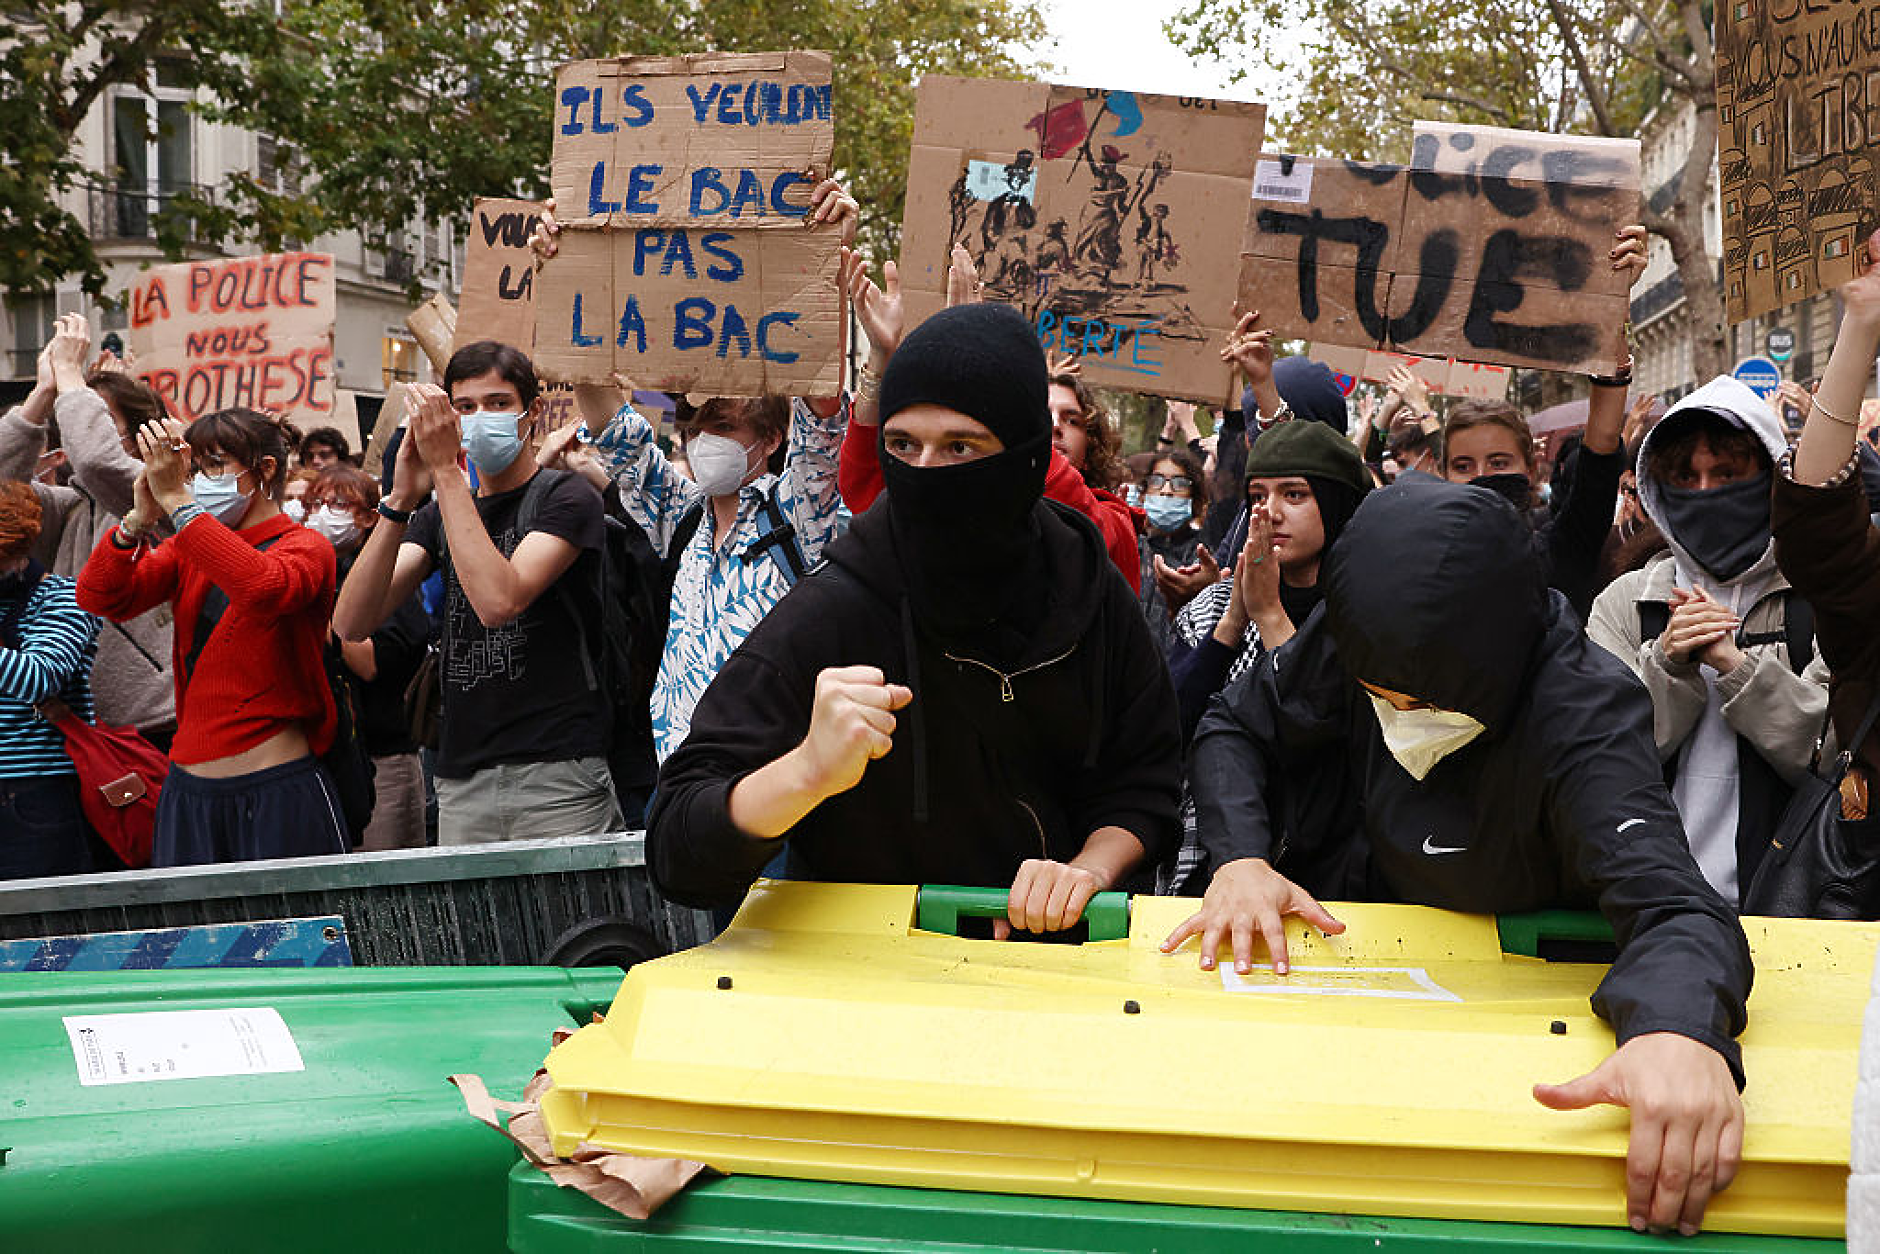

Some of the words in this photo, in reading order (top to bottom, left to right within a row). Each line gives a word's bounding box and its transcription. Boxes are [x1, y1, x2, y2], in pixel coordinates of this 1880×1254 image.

[560, 84, 656, 136] ILS
[588, 161, 663, 216] LE
[689, 166, 816, 218] BAC
[480, 210, 544, 248] VOU
[633, 228, 745, 282] PAS
[131, 279, 172, 328] LA
[187, 253, 332, 314] POLICE
[1256, 206, 1602, 364] TUE
[186, 322, 271, 358] NOUS
[572, 294, 648, 354] LA
[673, 297, 801, 364] BAC
